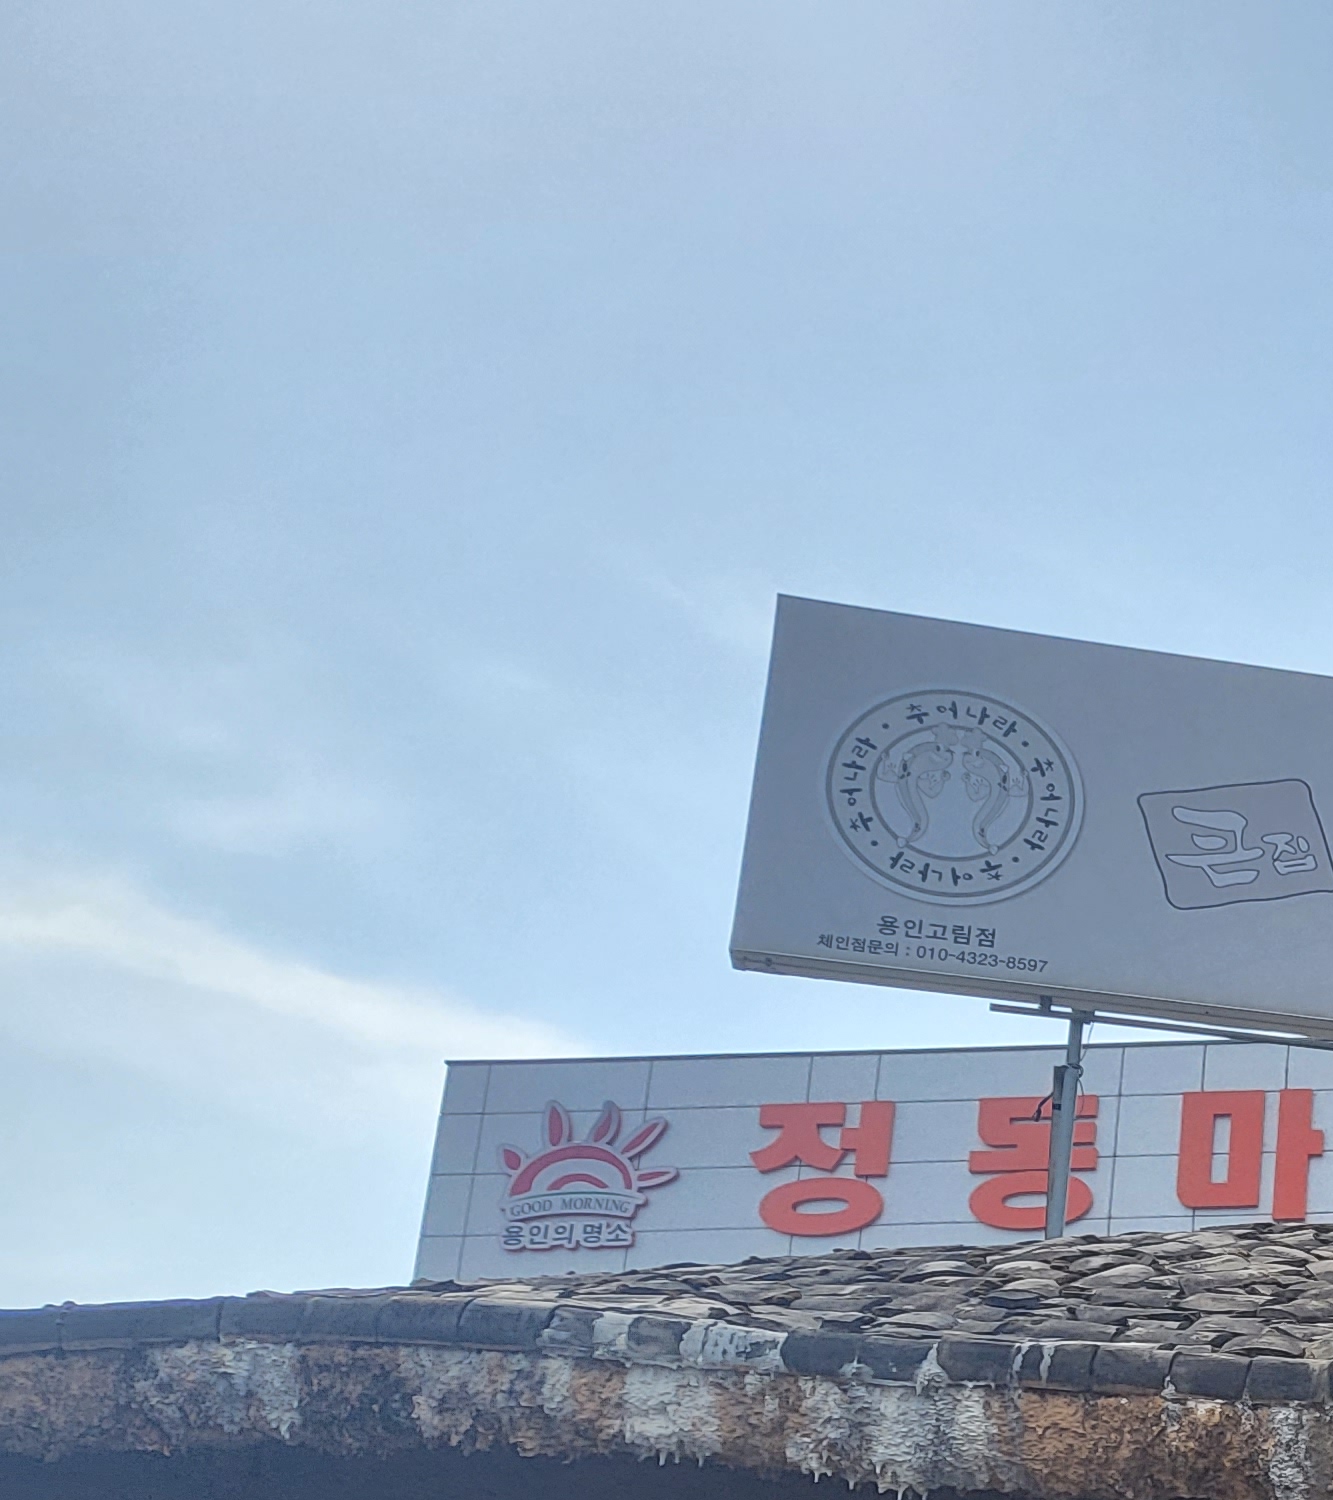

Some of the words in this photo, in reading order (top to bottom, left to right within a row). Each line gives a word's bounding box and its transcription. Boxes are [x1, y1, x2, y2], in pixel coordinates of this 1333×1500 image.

[905, 700, 1018, 738] 추어나라
[839, 736, 878, 832] 추어나라
[1023, 757, 1063, 851] 추어나라
[1164, 804, 1319, 889] 큰집
[876, 914, 997, 949] 용인고림점
[915, 945, 1049, 974] 010-4323-8597
[509, 1199, 553, 1217] GOOD
[560, 1197, 631, 1214] MORNING
